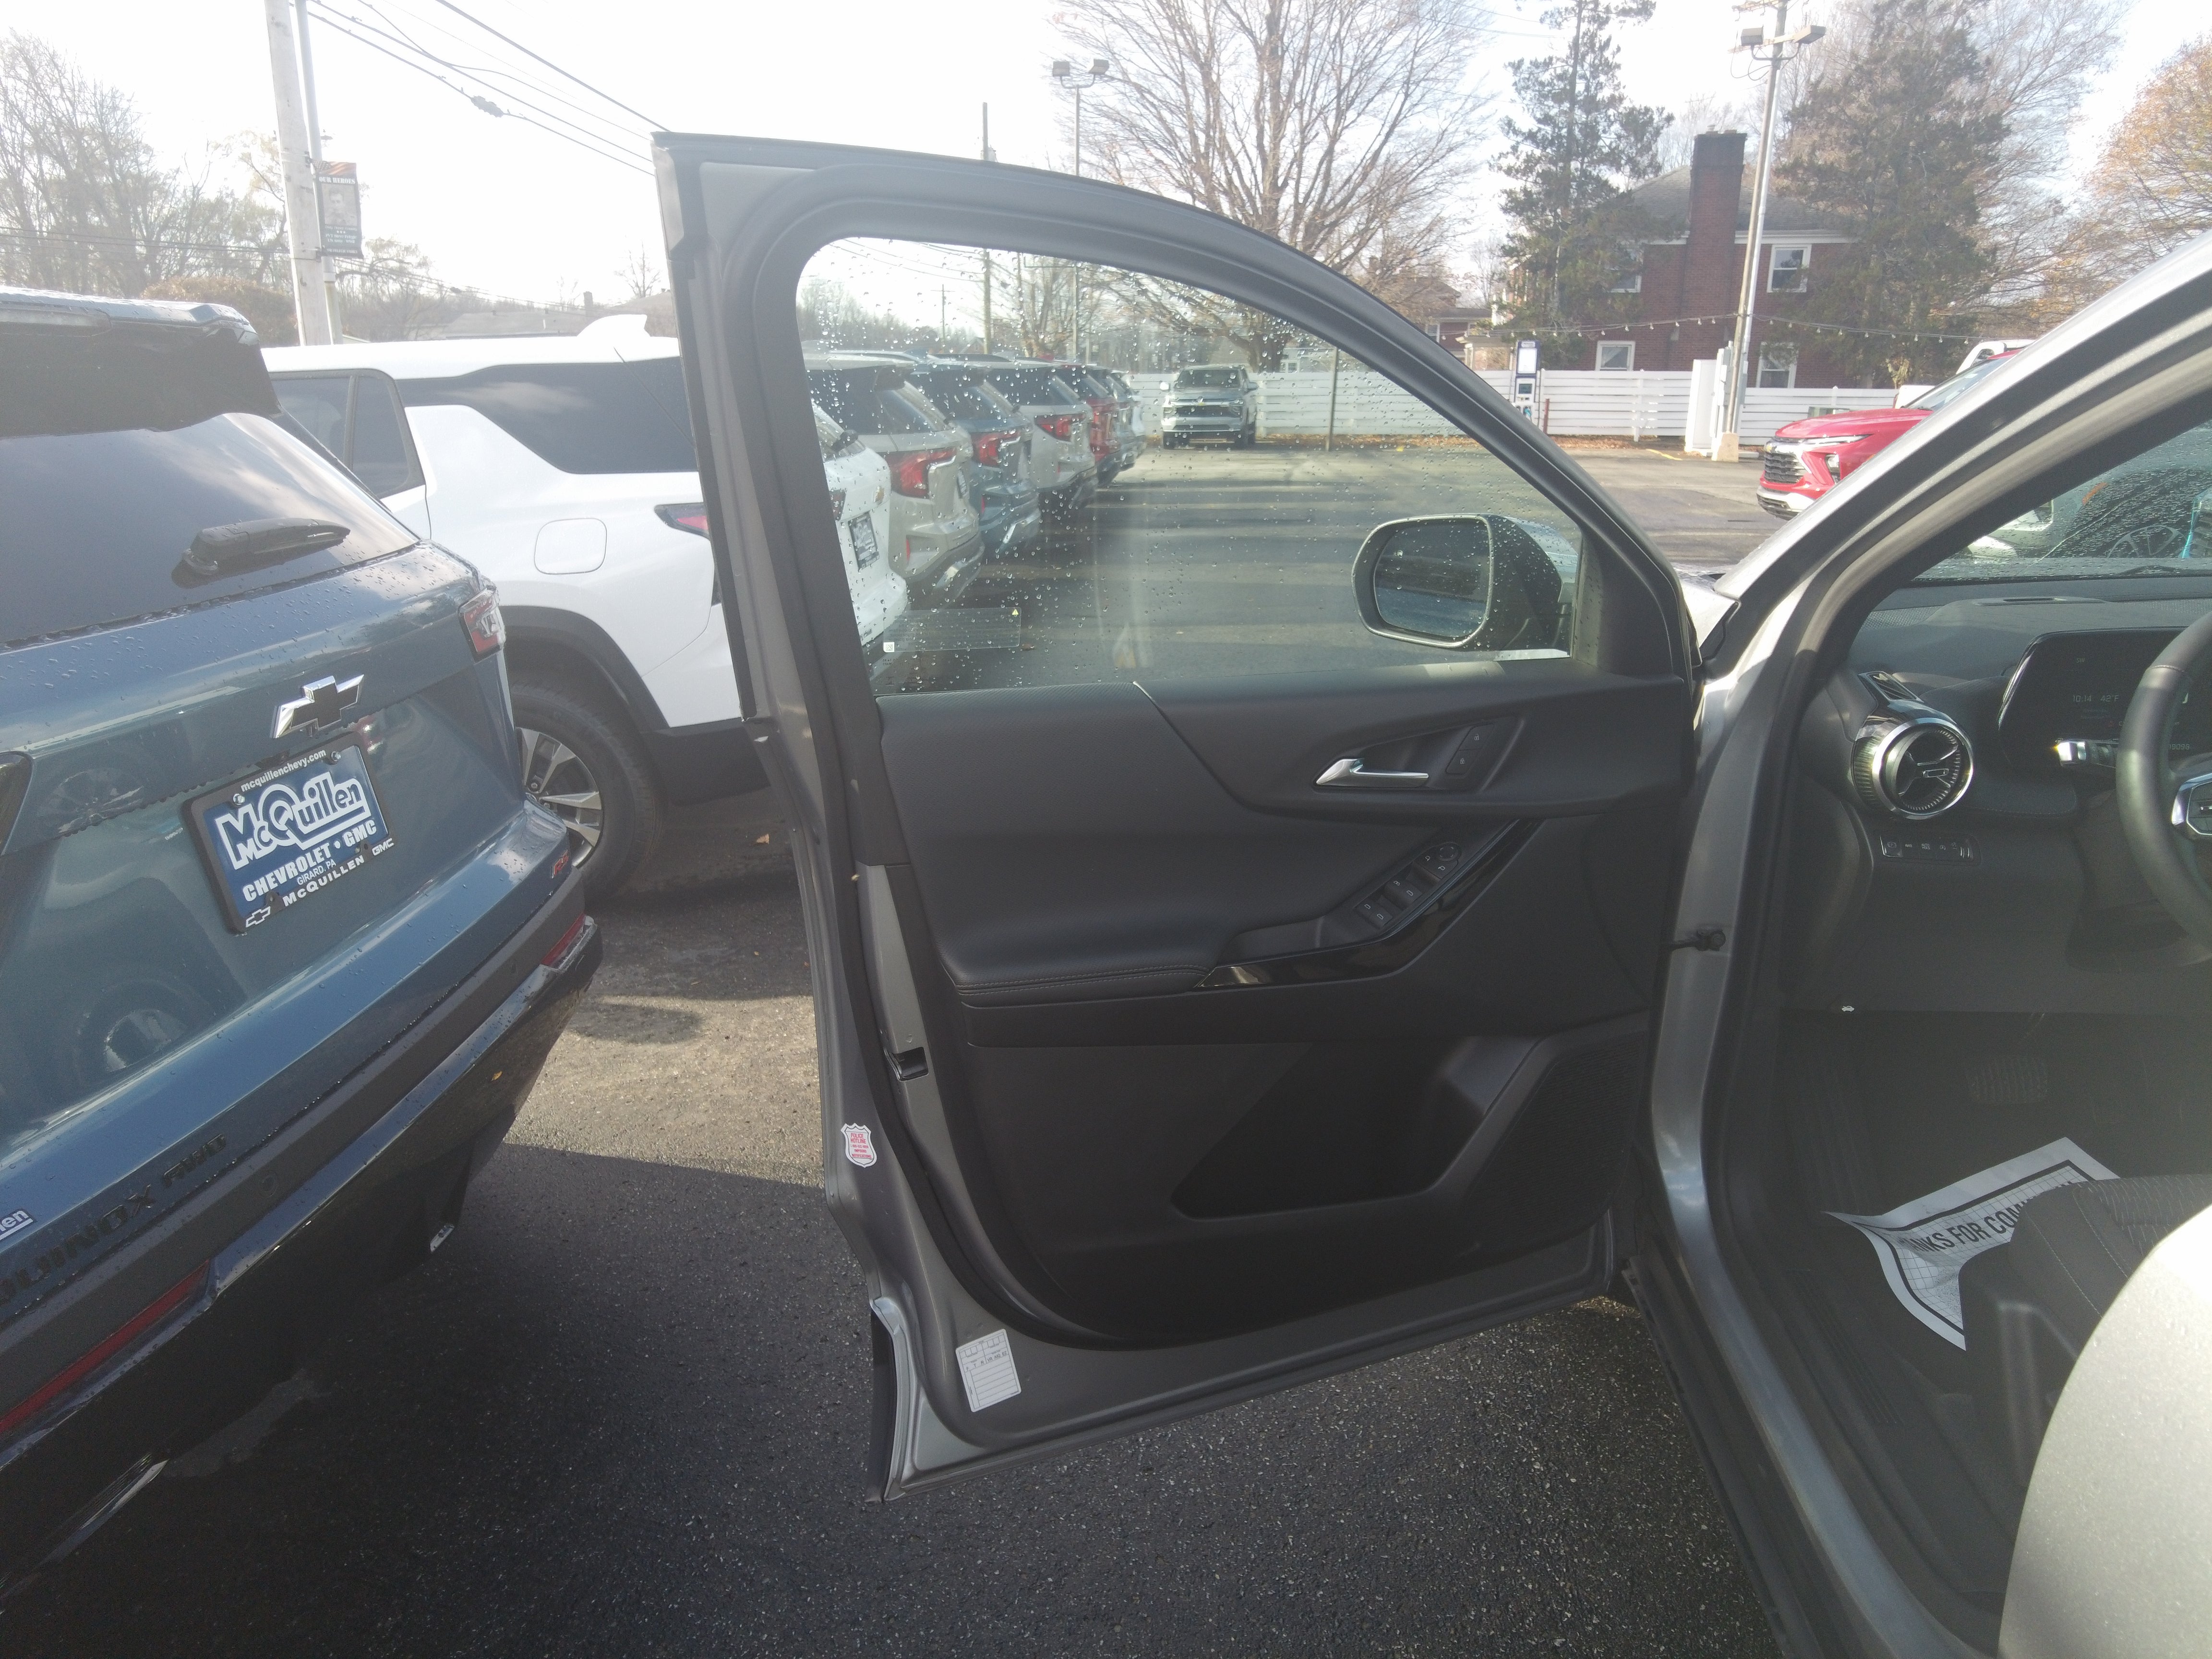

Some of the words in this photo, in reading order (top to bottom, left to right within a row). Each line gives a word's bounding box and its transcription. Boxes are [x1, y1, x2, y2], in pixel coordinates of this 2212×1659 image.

[240, 749, 326, 793] mcquillenchevy.com
[216, 772, 371, 870] McQuillen
[242, 845, 332, 902] CHEVROLET
[342, 820, 377, 847] GMC
[326, 860, 337, 872] PA
[372, 838, 395, 856] GMC
[283, 855, 365, 907] McQUILLEN
[1947, 1223, 1992, 1245] FOR
